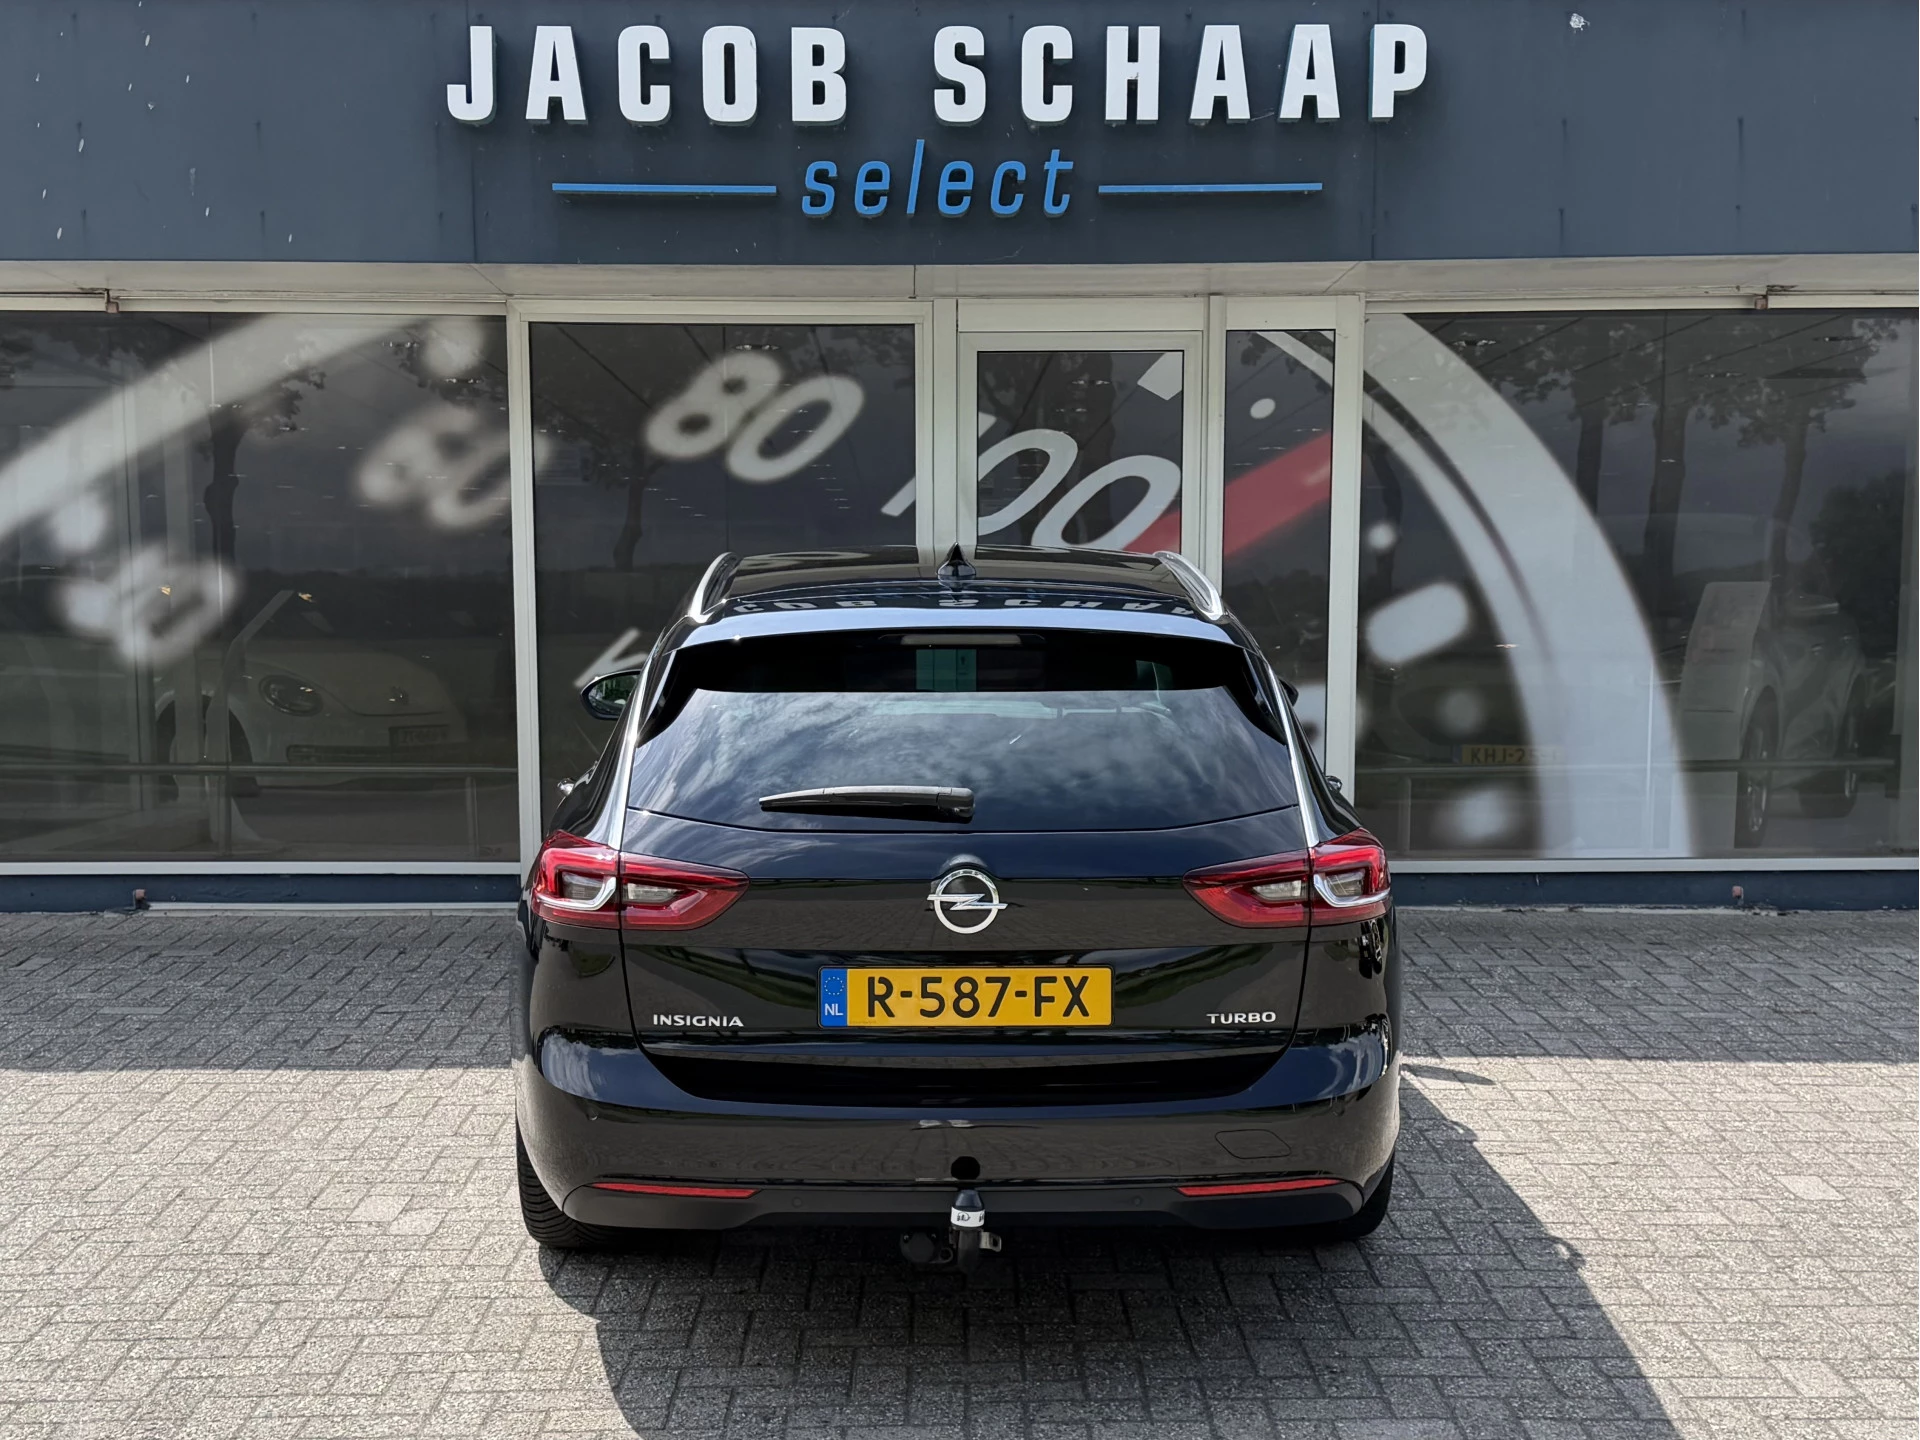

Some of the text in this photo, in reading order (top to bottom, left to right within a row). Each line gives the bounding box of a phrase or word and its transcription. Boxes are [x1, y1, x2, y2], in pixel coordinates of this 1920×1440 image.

[446, 24, 1427, 124] JACOB SCHAAP
[801, 139, 1074, 217] select
[645, 349, 865, 484] 80
[653, 1014, 745, 1027] INSIGNIA
[823, 976, 1090, 1018] NL R-587-FX
[1206, 1011, 1277, 1025] TURBO
